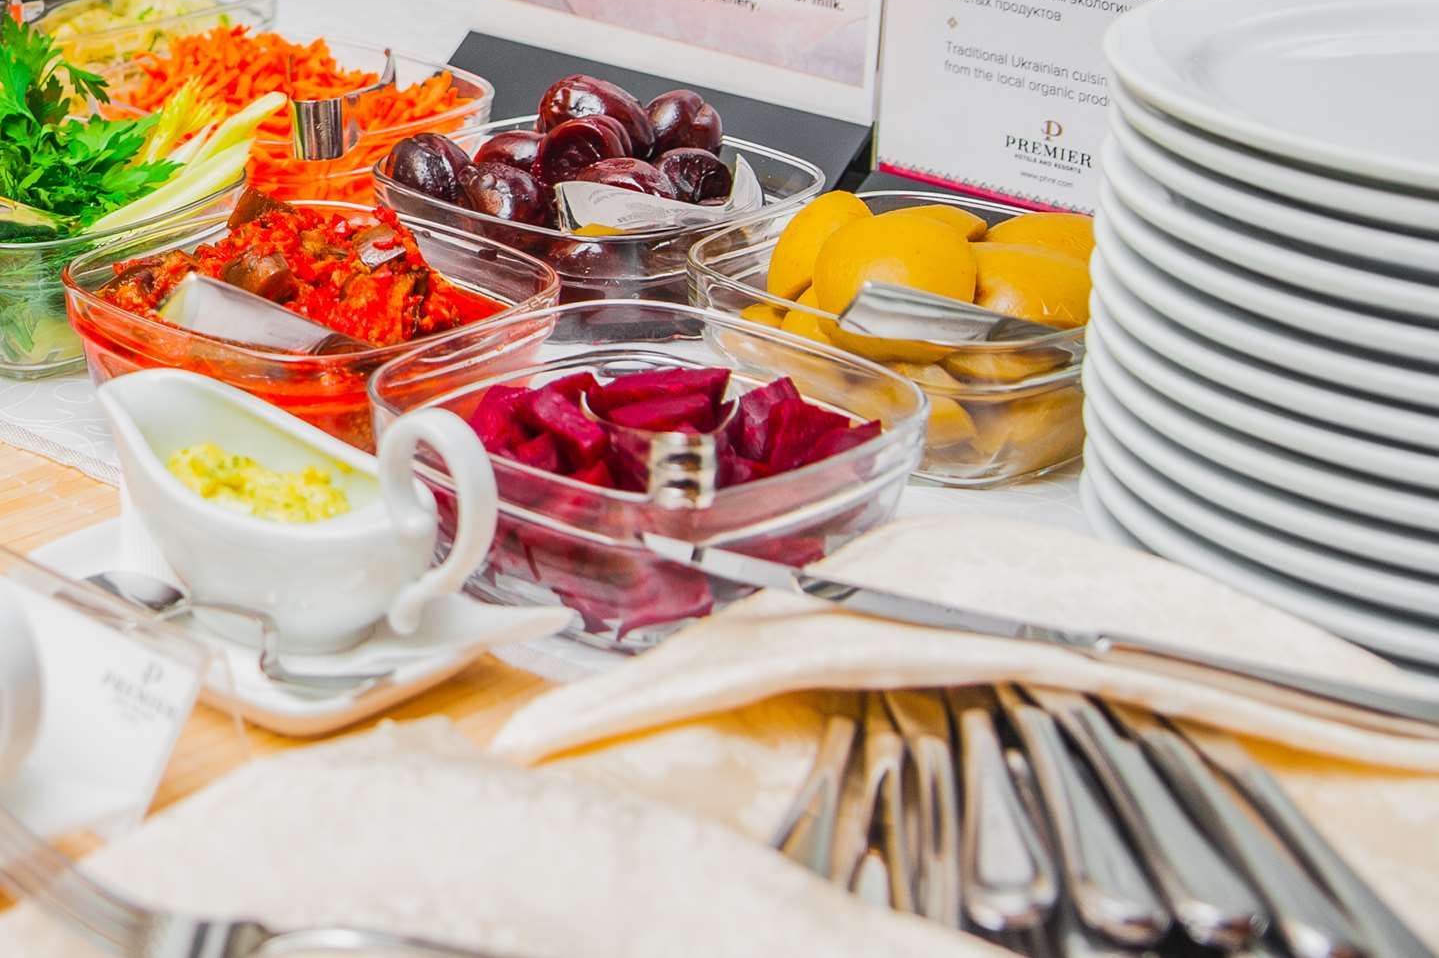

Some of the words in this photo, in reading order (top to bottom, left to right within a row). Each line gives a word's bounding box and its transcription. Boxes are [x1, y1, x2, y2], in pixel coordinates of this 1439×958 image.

[996, 1, 1062, 22] продуктов
[946, 41, 1008, 65] Traditional
[1012, 54, 1069, 80] Ukrainian
[1072, 70, 1108, 87] cuisin
[944, 60, 970, 77] from
[974, 66, 994, 82] the
[997, 71, 1025, 89] local
[1028, 80, 1074, 100] organic
[1079, 87, 1110, 108] prod
[1005, 135, 1092, 168] PREMIER
